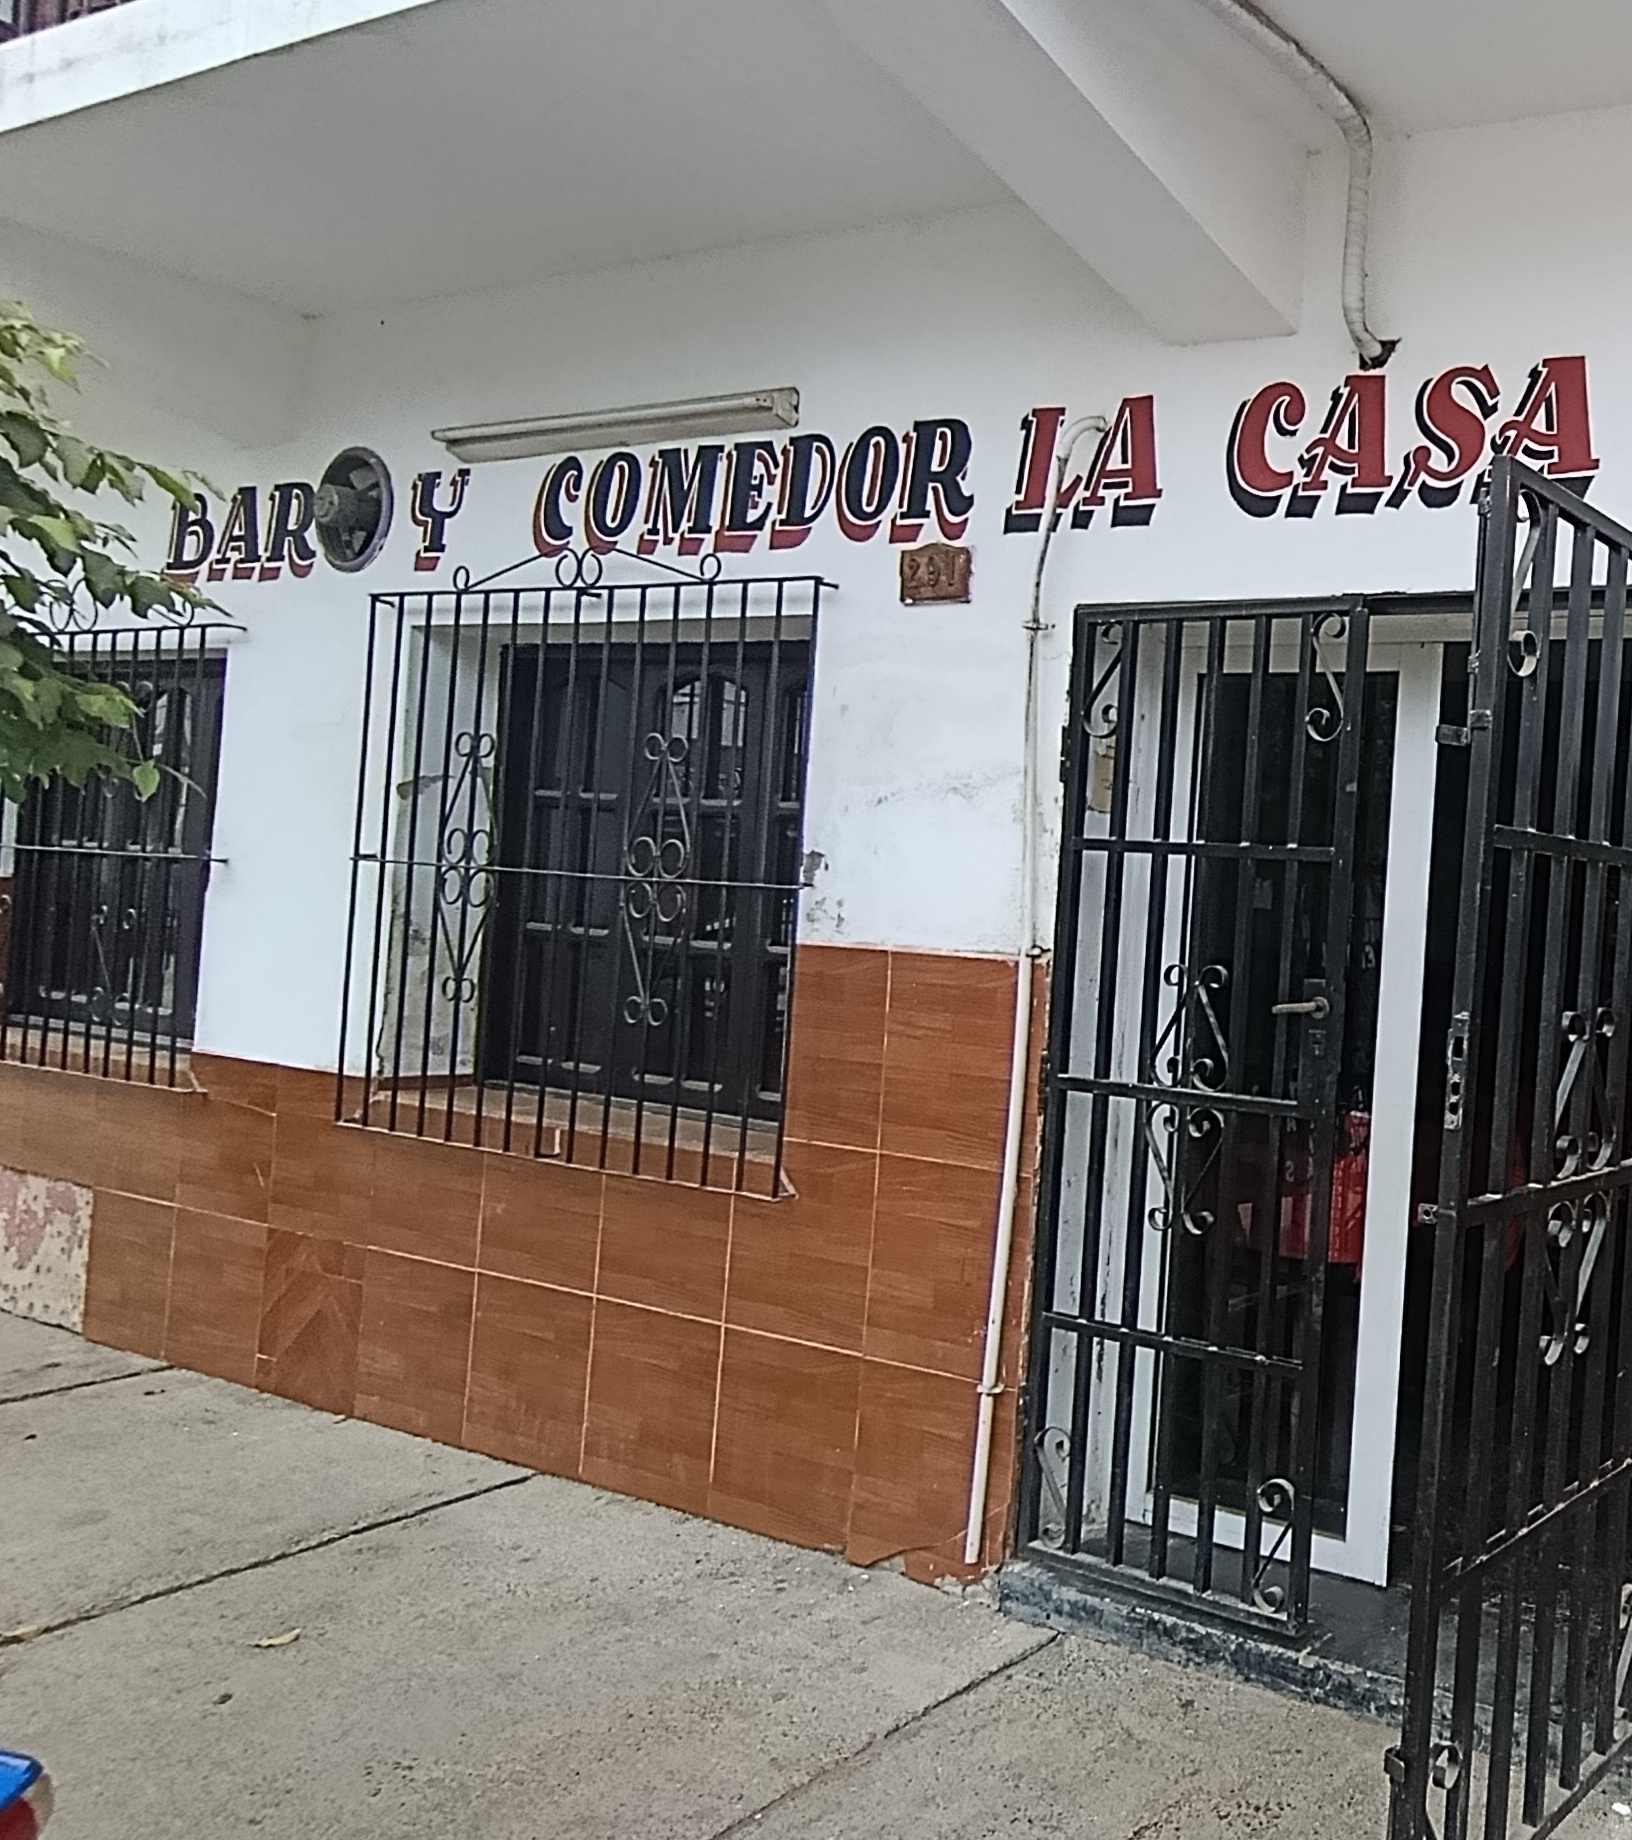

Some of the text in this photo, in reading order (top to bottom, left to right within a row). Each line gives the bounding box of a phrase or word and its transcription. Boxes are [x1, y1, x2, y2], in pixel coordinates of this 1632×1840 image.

[164, 480, 318, 582] BAR
[411, 468, 470, 572] Y
[532, 416, 975, 554] COMEDOR
[1004, 395, 1162, 534] LA
[1226, 354, 1600, 519] CASA
